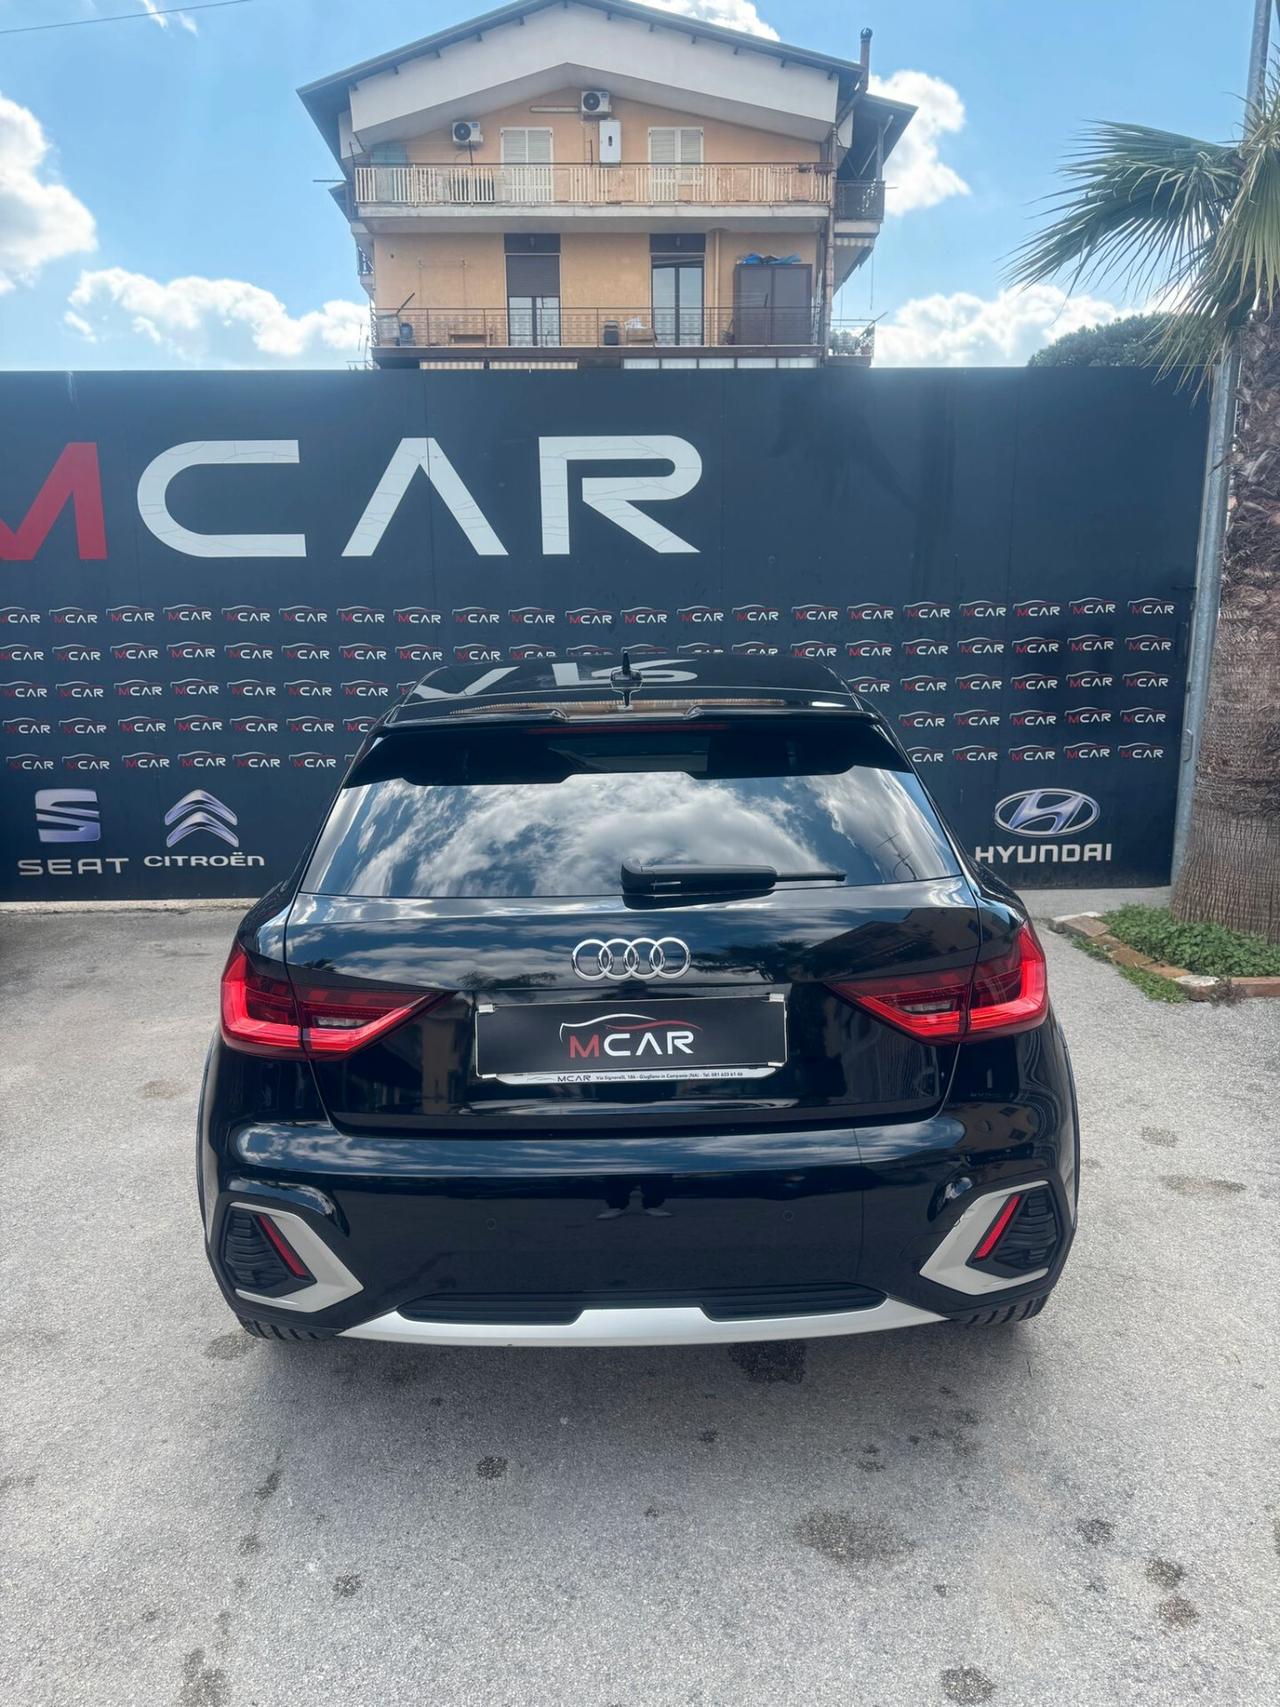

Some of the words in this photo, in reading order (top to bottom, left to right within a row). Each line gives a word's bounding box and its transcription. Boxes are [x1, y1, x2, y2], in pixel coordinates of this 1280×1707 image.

[907, 608, 951, 619] MCAR
[963, 606, 1007, 617] MCAR
[1017, 606, 1061, 617] MCAR
[1072, 603, 1116, 614] MCAR
[1131, 604, 1175, 615] MCAR
[54, 613, 98, 624] MCAR
[111, 611, 155, 622] MCAR
[168, 610, 212, 621] MCAR
[226, 611, 270, 622] MCAR
[284, 612, 328, 623] MCAR
[341, 612, 385, 623] MCAR
[398, 613, 442, 624] MCAR
[456, 613, 500, 624] MCAR
[512, 613, 556, 624] MCAR
[569, 614, 613, 625] MCAR
[624, 613, 668, 624] MCAR
[680, 611, 724, 622] MCAR
[735, 610, 779, 621] MCAR
[795, 610, 839, 621] MCAR
[850, 609, 894, 620] MCAR
[905, 644, 949, 655] MCAR
[961, 643, 1005, 654] MCAR
[1015, 643, 1059, 654] MCAR
[1071, 640, 1115, 651] MCAR
[1128, 640, 1172, 651] MCAR
[0, 650, 44, 661] MCAR
[57, 650, 101, 661] MCAR
[115, 648, 159, 659] MCAR
[172, 647, 216, 658] MCAR
[229, 648, 273, 659] MCAR
[286, 649, 330, 660] MCAR
[343, 649, 387, 660] MCAR
[399, 650, 443, 661] MCAR
[457, 650, 501, 661] MCAR
[793, 646, 837, 657] MCAR
[848, 646, 892, 657] MCAR
[903, 681, 947, 692] MCAR
[959, 679, 1003, 690] MCAR
[1014, 679, 1058, 690] MCAR
[1069, 676, 1113, 687] MCAR
[1125, 677, 1169, 688] MCAR
[4, 687, 48, 698] MCAR
[60, 687, 104, 698] MCAR
[119, 685, 163, 696] MCAR
[175, 684, 219, 695] MCAR
[232, 685, 276, 696] MCAR
[289, 686, 333, 697] MCAR
[345, 686, 389, 697] MCAR
[902, 717, 946, 728] MCAR
[957, 715, 1001, 726] MCAR
[1013, 715, 1057, 726] MCAR
[1068, 712, 1112, 723] MCAR
[1123, 713, 1167, 724] MCAR
[7, 723, 51, 734] MCAR
[63, 723, 107, 734] MCAR
[123, 722, 167, 733] MCAR
[179, 720, 223, 731] MCAR
[234, 722, 278, 733] MCAR
[291, 722, 335, 733] MCAR
[955, 751, 999, 762] MCAR
[1012, 750, 1056, 761] MCAR
[1067, 748, 1111, 759] MCAR
[1120, 748, 1164, 759] MCAR
[10, 759, 54, 770] MCAR
[66, 759, 110, 770] MCAR
[126, 758, 170, 769] MCAR
[182, 756, 226, 767] MCAR
[237, 757, 281, 768] MCAR
[293, 757, 337, 768] MCAR
[143, 851, 265, 867] CITROËN
[975, 843, 1112, 864] HYUNDAI
[17, 857, 129, 876] SEAT
[569, 1031, 694, 1058] MCAR
